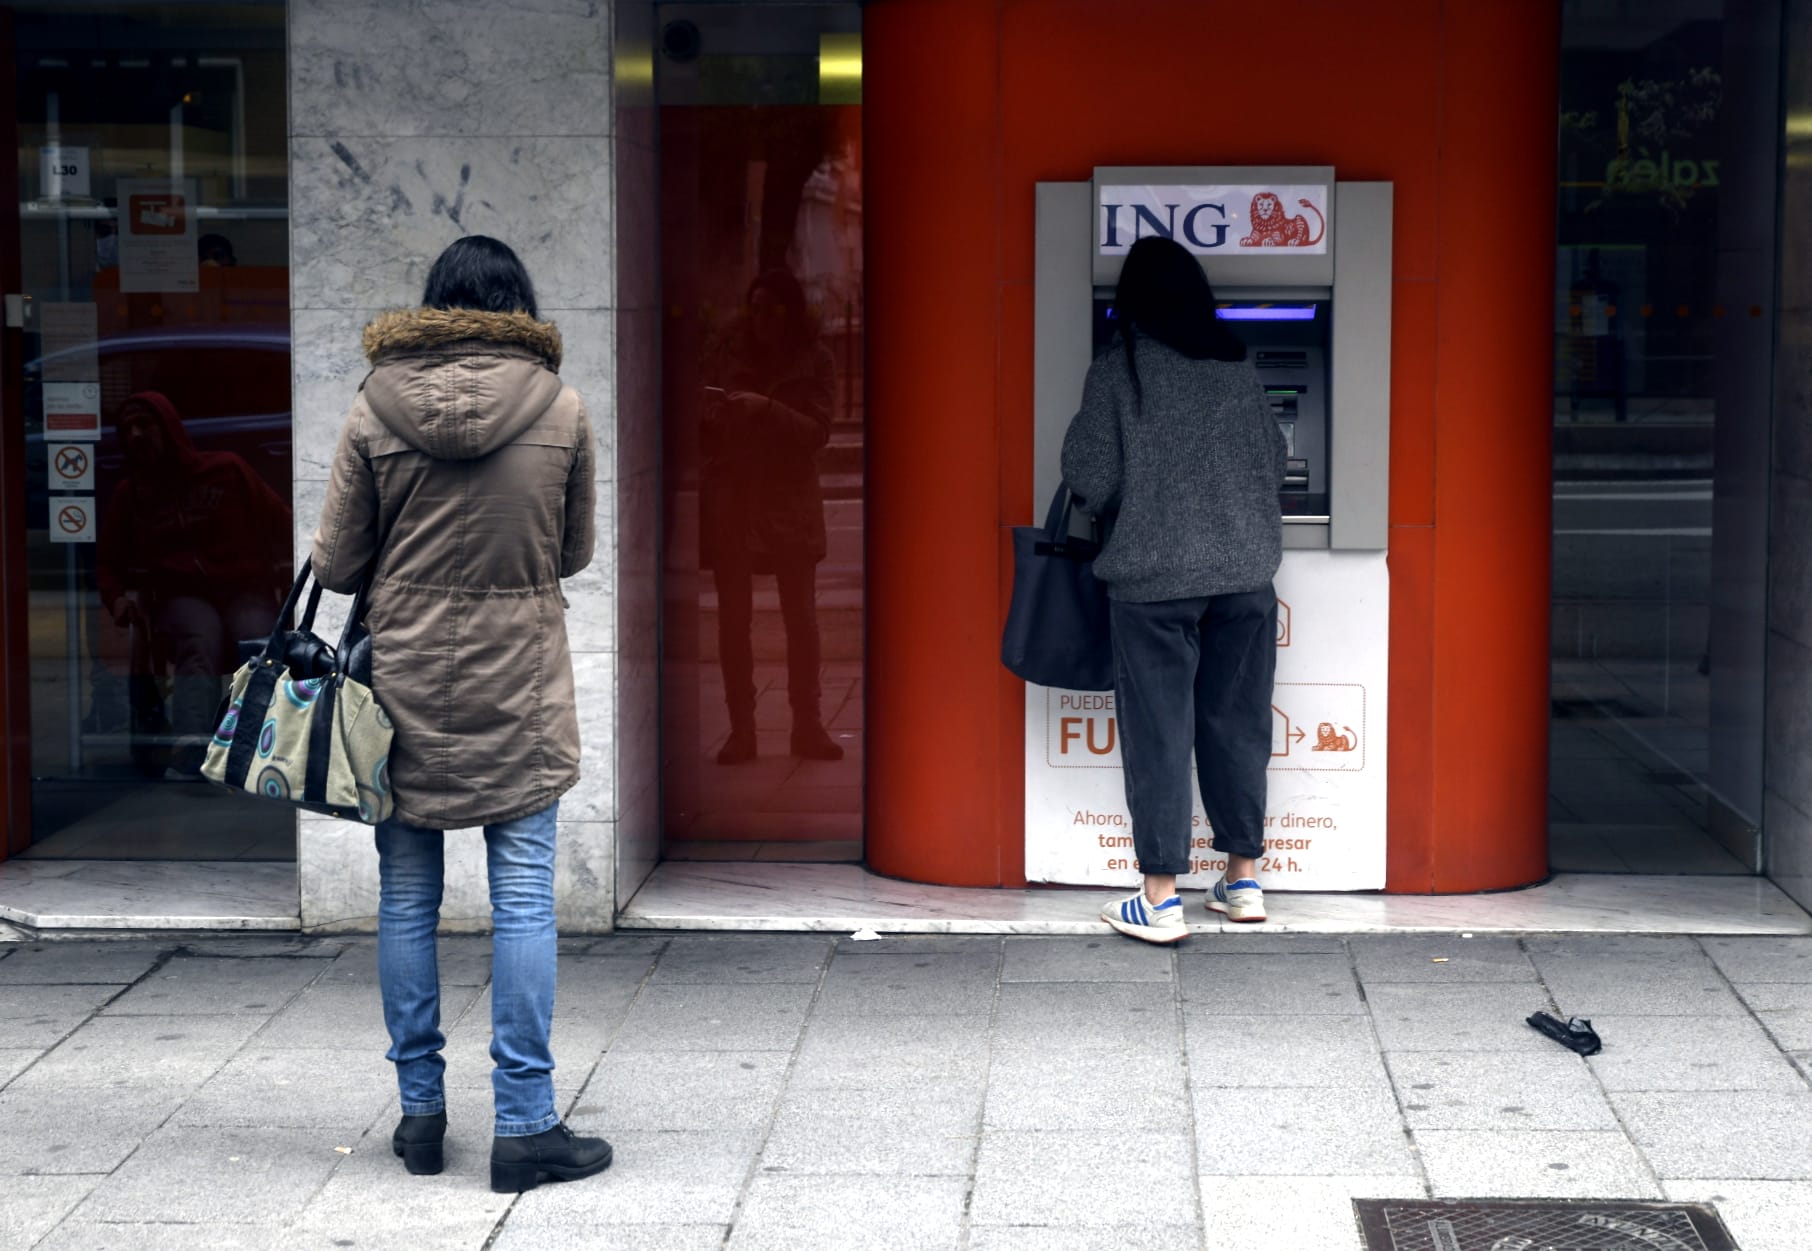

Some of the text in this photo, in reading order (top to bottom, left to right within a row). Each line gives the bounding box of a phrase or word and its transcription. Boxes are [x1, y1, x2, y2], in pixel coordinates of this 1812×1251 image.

[1101, 203, 1230, 248] ING
[1060, 695, 1114, 710] PUEDE
[1060, 717, 1115, 755] FU
[1073, 810, 1127, 828] Ahora,
[1280, 812, 1337, 830] dinero,
[1098, 833, 1133, 848] tam
[1107, 858, 1128, 871] en
[1189, 856, 1227, 875] jero
[1261, 857, 1283, 872] 24
[1288, 857, 1302, 873] h.
